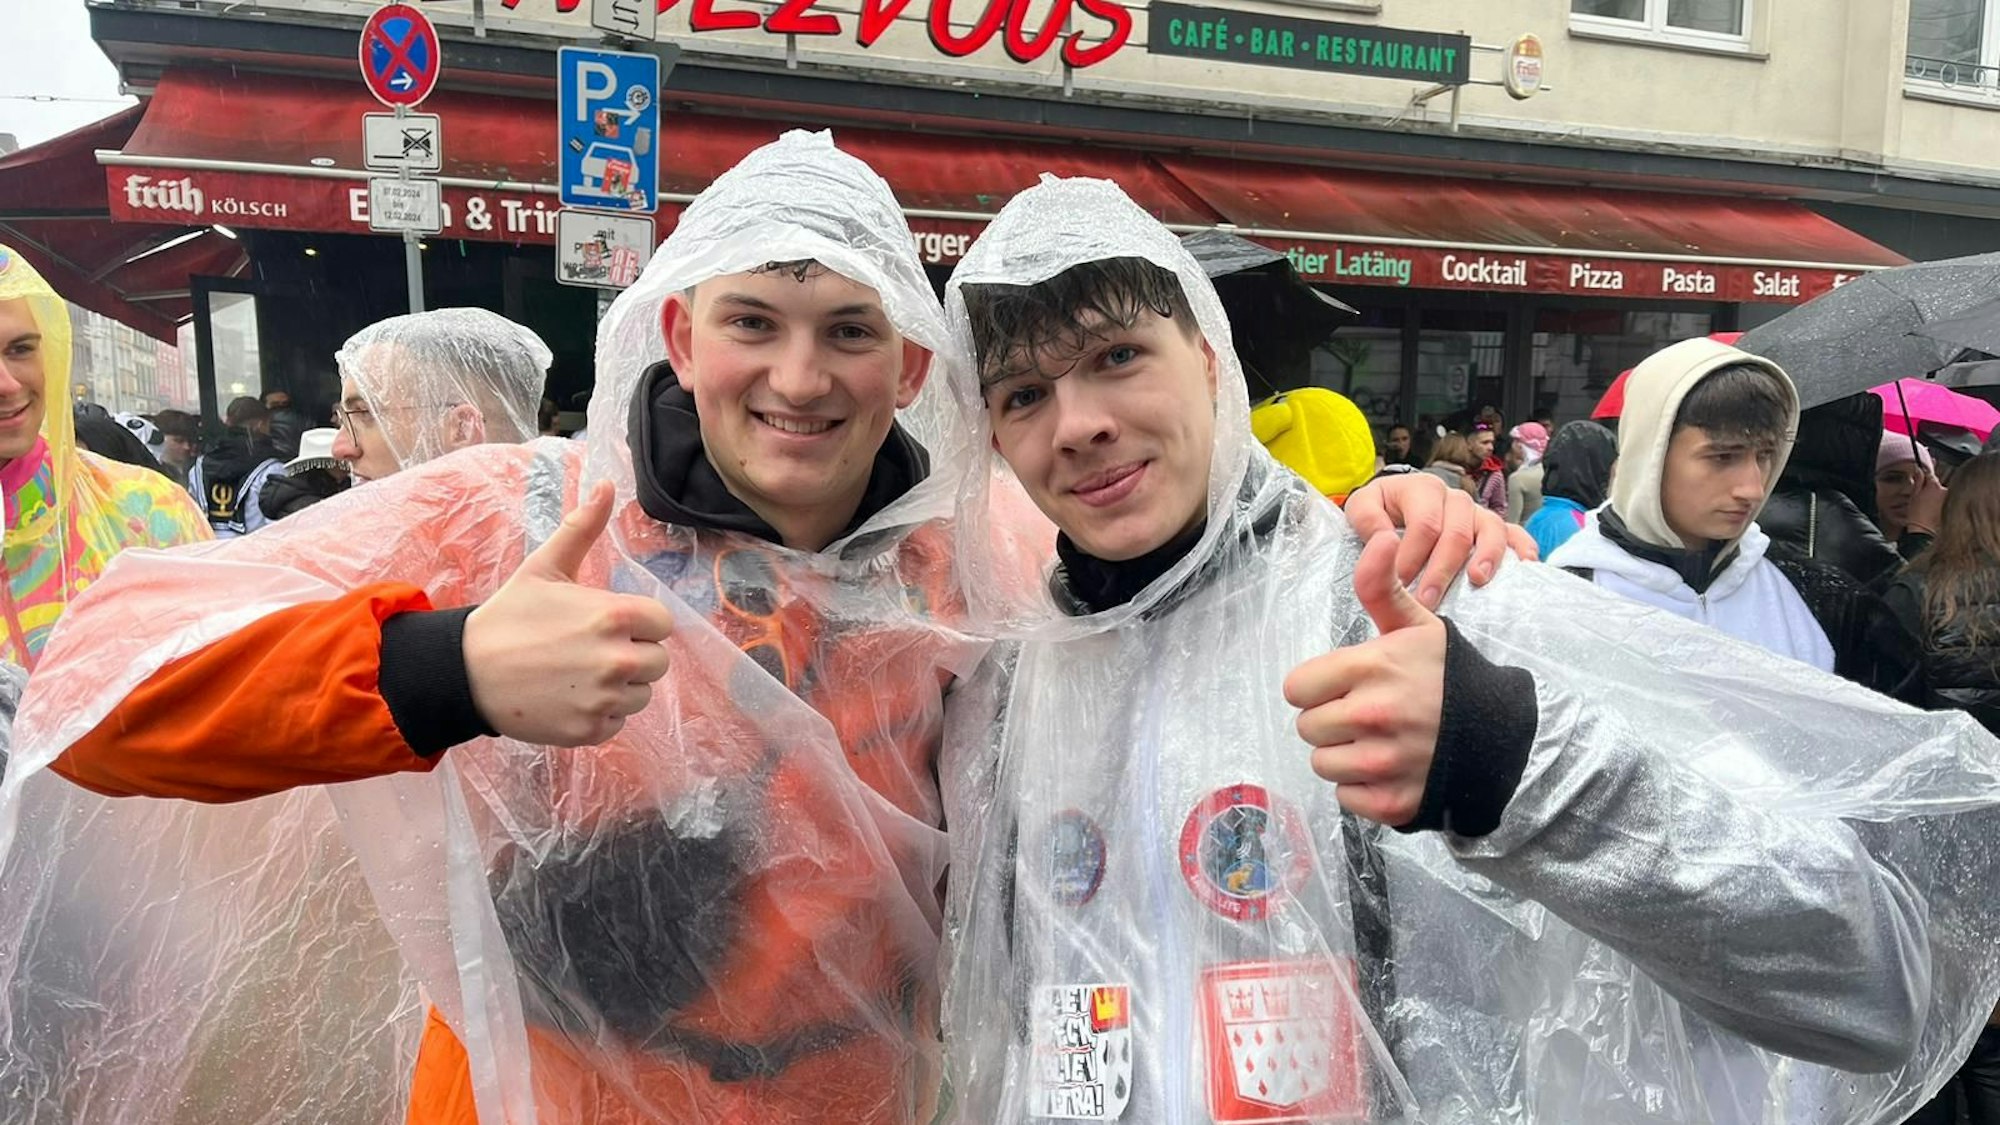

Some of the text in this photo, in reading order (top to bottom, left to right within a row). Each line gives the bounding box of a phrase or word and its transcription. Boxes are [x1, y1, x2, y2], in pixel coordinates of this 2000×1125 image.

[1168, 17, 1456, 74] CAFÉ BAR RESTAURANT
[576, 60, 618, 122] P
[210, 198, 288, 217] KÖLSCH
[465, 196, 493, 231] &
[913, 232, 971, 263] rger
[1287, 246, 1411, 285] tier Latäng
[1441, 254, 1527, 286] Cocktail
[1569, 263, 1624, 290] Pizza
[1662, 268, 1716, 294] Pasta
[1753, 271, 1800, 298] Salat
